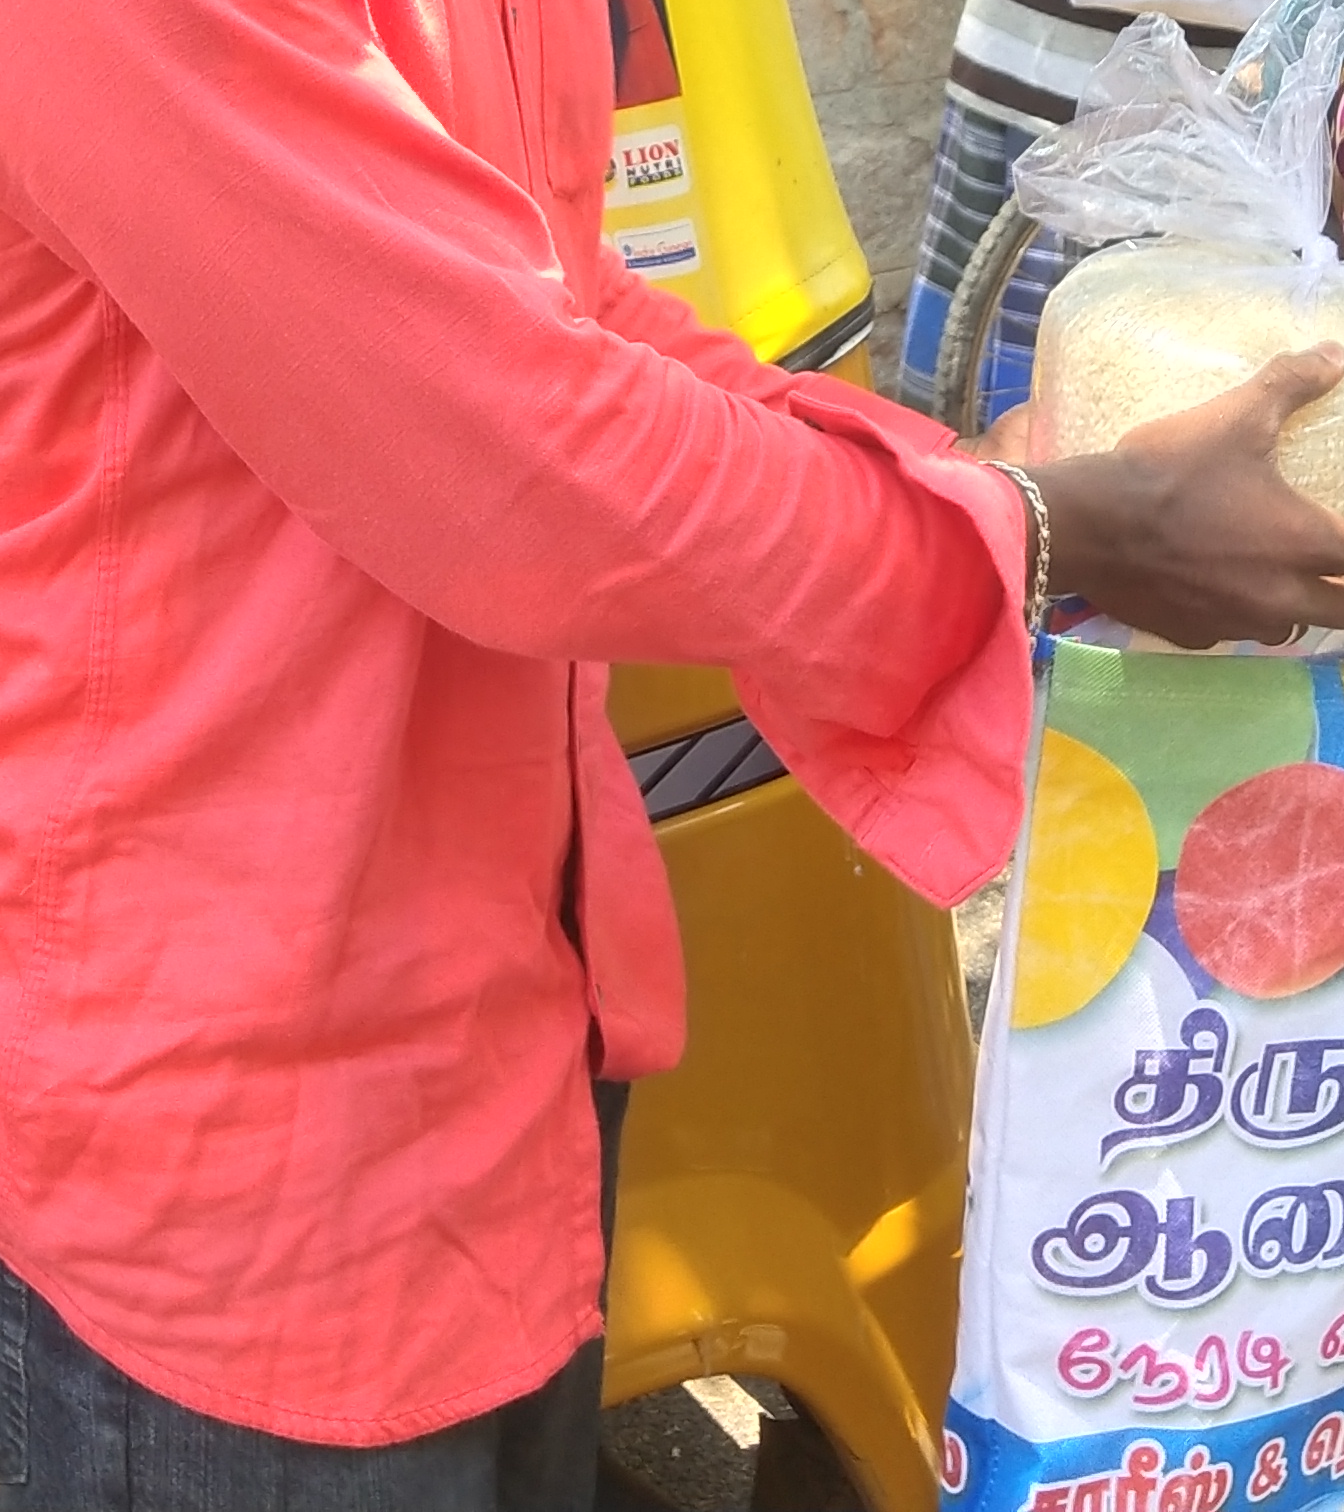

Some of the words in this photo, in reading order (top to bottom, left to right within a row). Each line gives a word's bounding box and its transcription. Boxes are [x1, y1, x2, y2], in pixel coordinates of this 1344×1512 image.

[622, 138, 679, 167] LION
[1056, 1327, 1290, 1407] நேரடி
[1250, 1438, 1286, 1500] &
